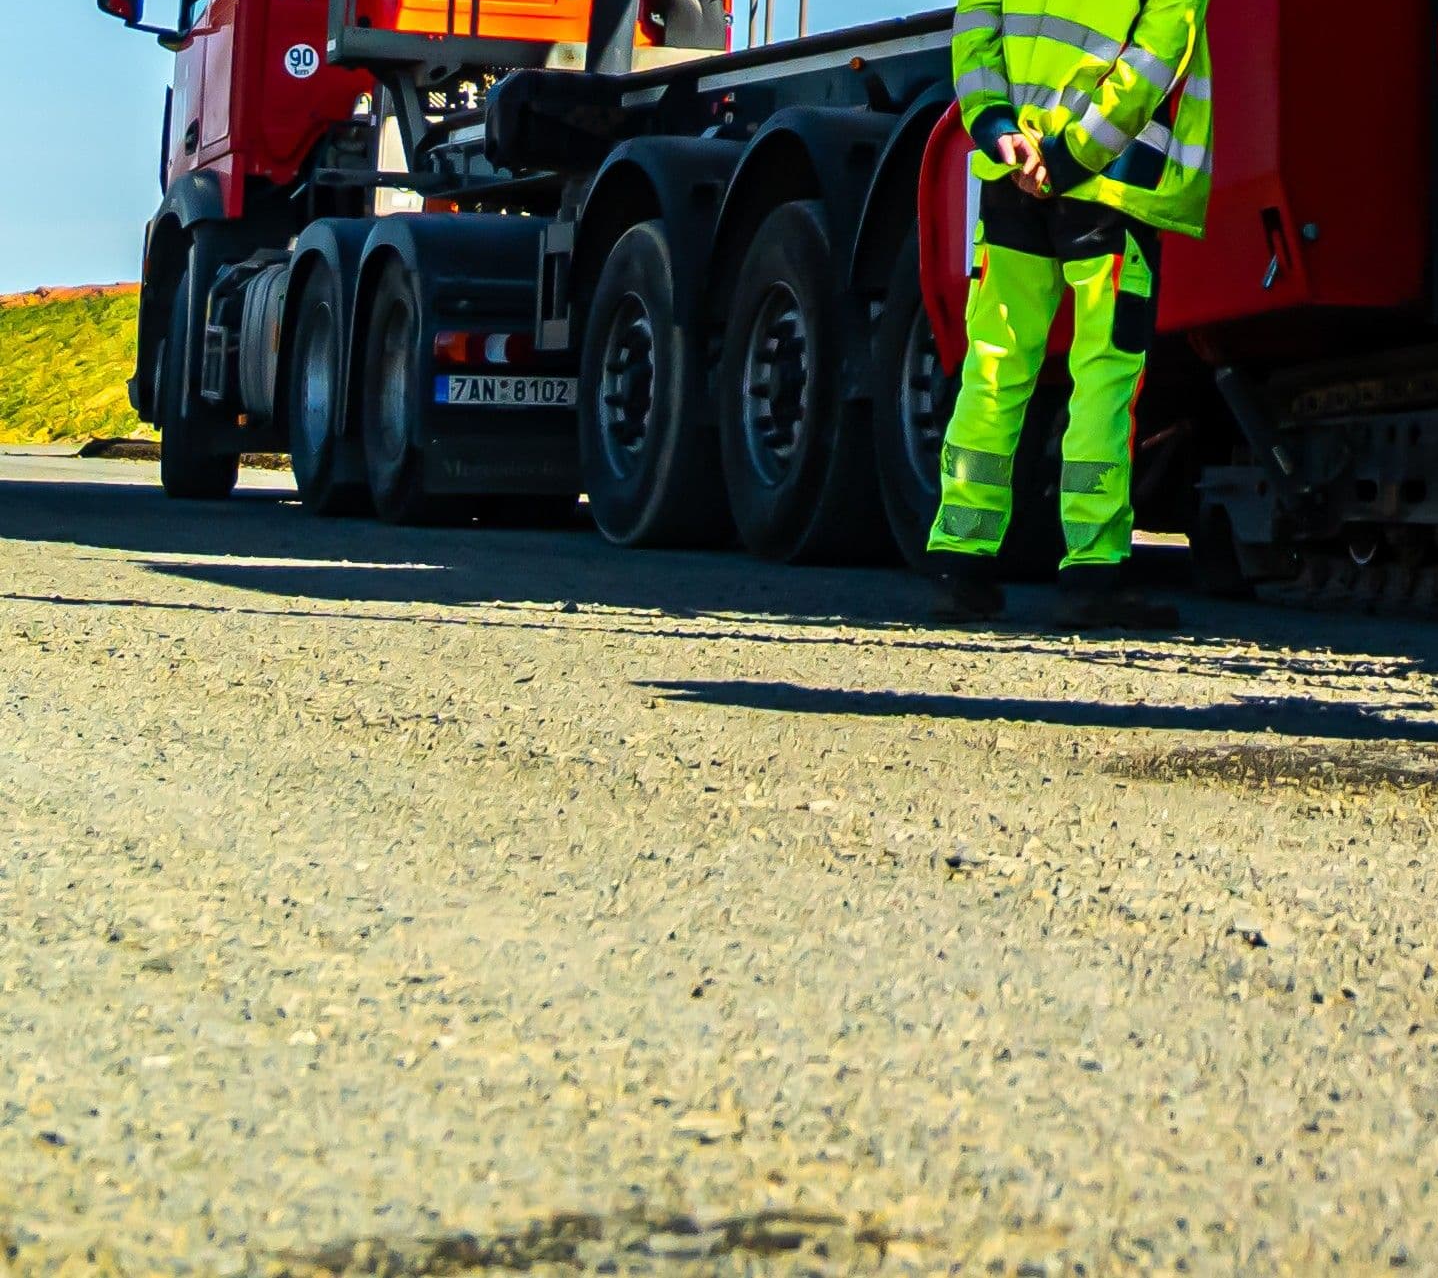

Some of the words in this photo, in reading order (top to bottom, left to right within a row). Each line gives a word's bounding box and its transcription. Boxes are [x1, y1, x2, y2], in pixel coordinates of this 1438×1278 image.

[290, 48, 314, 66] 90
[455, 378, 496, 402] 7AN
[513, 380, 569, 403] 8102
